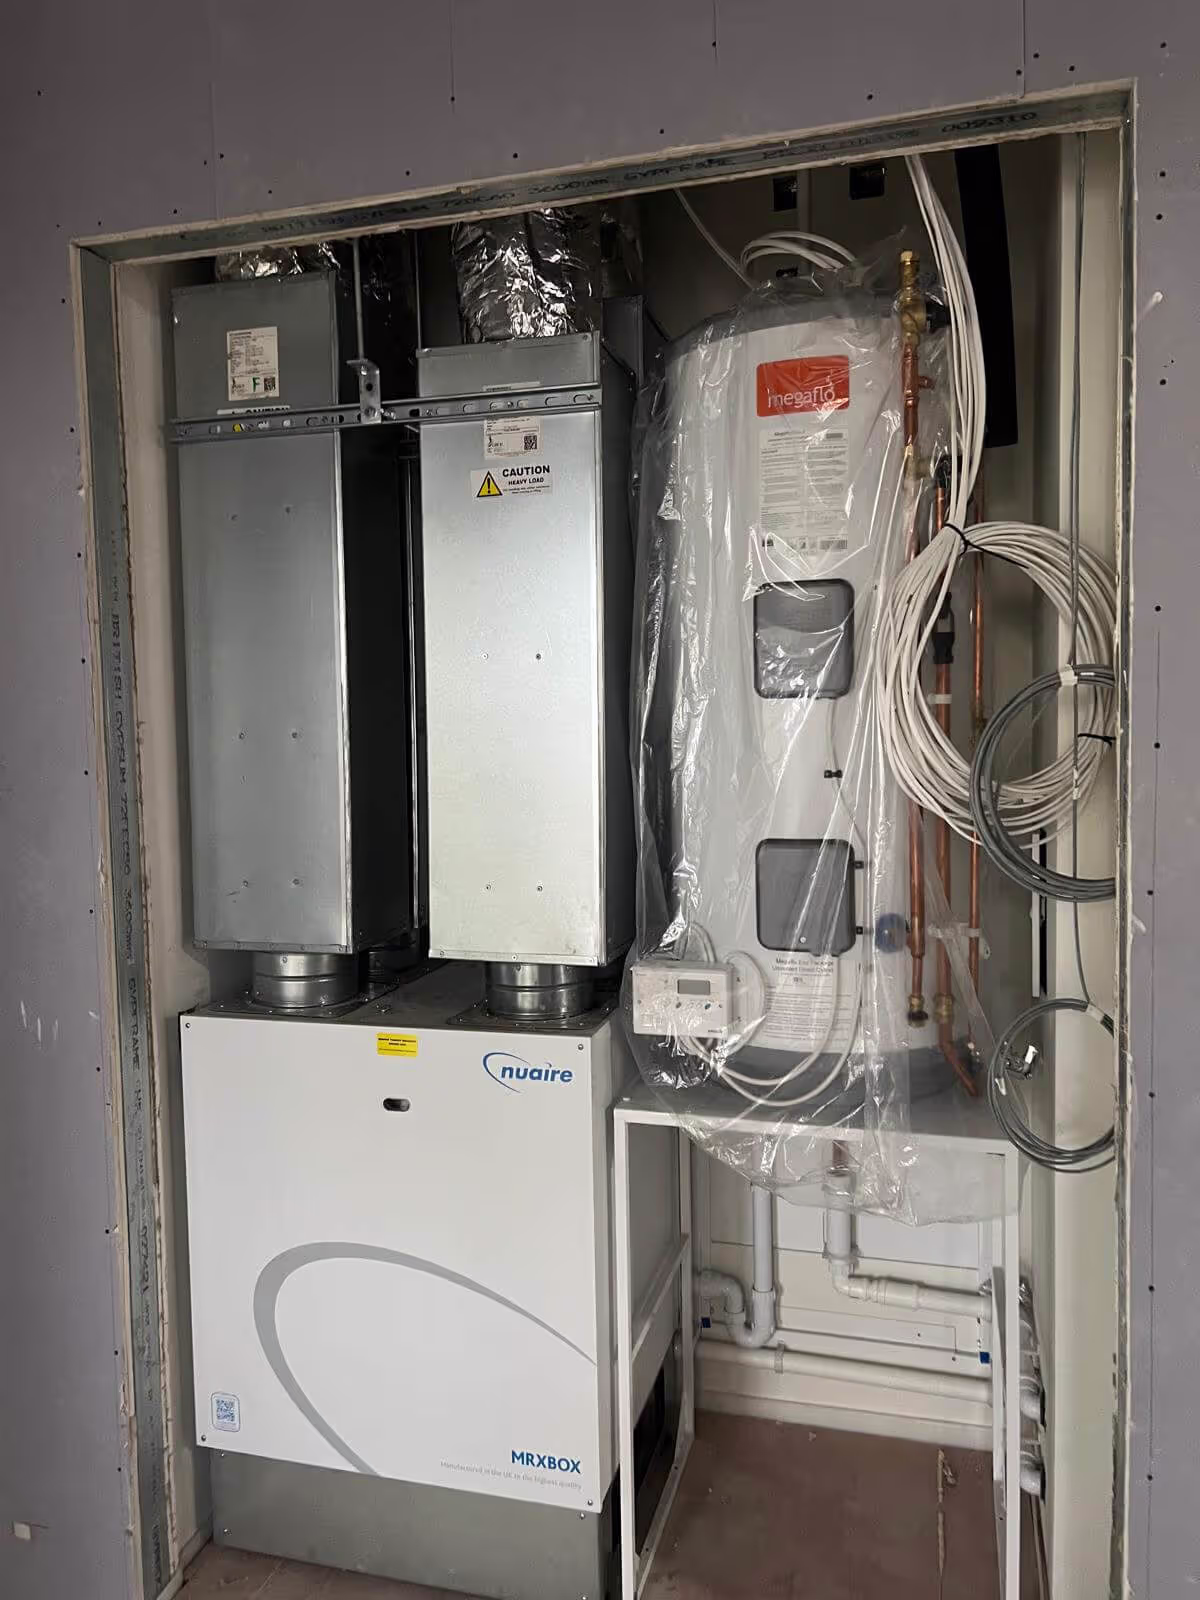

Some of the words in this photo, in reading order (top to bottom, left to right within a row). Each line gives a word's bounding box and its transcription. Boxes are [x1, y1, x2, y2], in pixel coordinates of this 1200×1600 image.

[502, 464, 550, 478] CAUTION
[508, 478, 527, 486] HEAVY
[115, 710, 128, 785] GYPSUM
[500, 1063, 573, 1083] nuaire
[511, 1449, 581, 1474] MRXBOX
